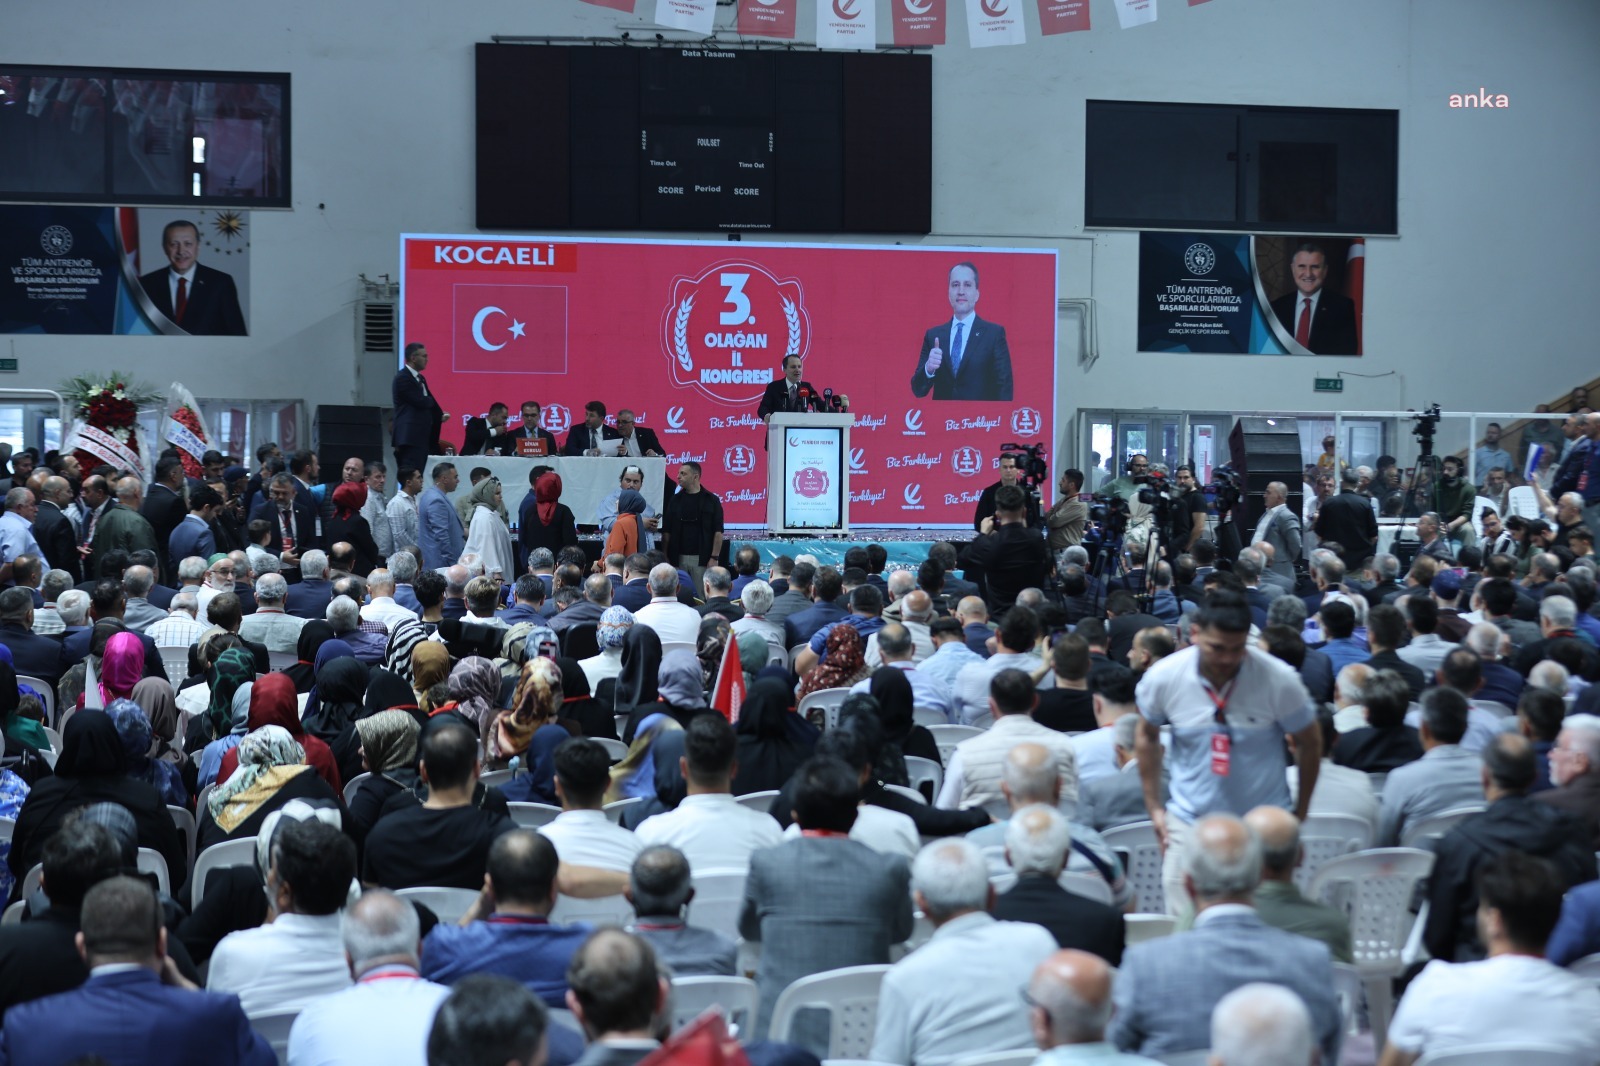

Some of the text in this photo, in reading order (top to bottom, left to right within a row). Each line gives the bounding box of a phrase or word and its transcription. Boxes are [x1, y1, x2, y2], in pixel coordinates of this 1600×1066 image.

[658, 186, 684, 194] SCORE
[21, 257, 93, 267] TÜM ANTRENÖR
[434, 244, 555, 266] KOCAELİ
[11, 267, 23, 275] VE
[1166, 285, 1232, 294] TÜM ANTRENÖR
[720, 273, 756, 325] 3.
[1169, 294, 1242, 304] SPORCULARIMIZA
[704, 330, 767, 348] OLAĞAN
[732, 350, 743, 367] İL
[700, 368, 773, 384] KONGRESİ
[709, 417, 724, 429] Biz
[850, 414, 887, 431] arklıyız!
[945, 416, 1001, 432] Biz Farklıyız!
[886, 453, 942, 469] Biz Farklıyız!
[944, 494, 958, 505] Biz
